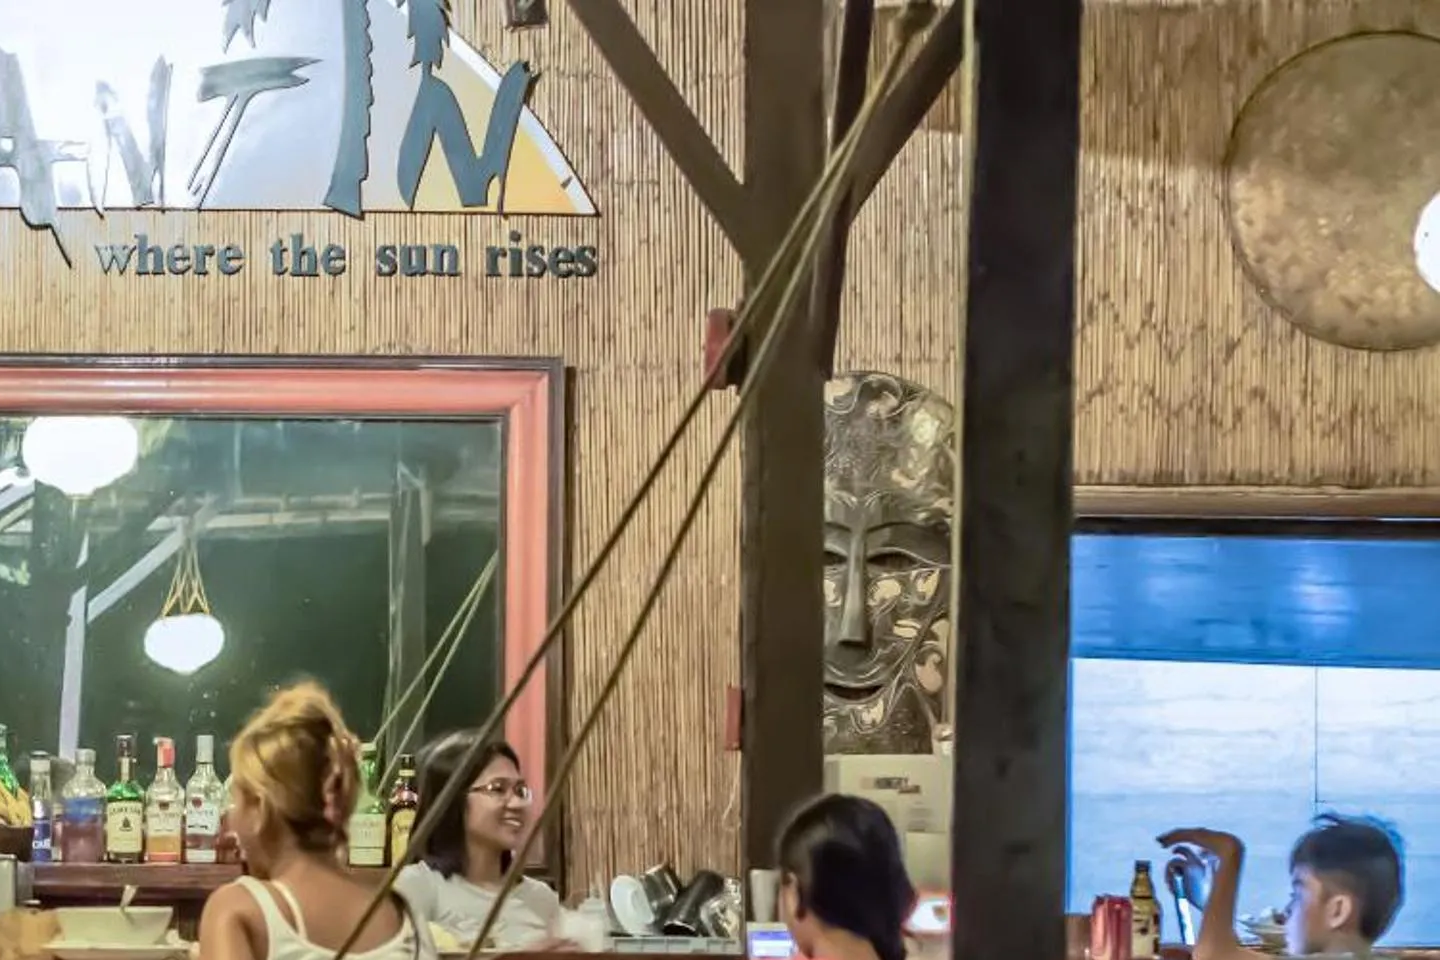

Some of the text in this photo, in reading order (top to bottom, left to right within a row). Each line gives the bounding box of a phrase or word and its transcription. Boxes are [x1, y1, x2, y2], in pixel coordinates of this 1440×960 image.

[94, 229, 598, 278] where the sun rises
